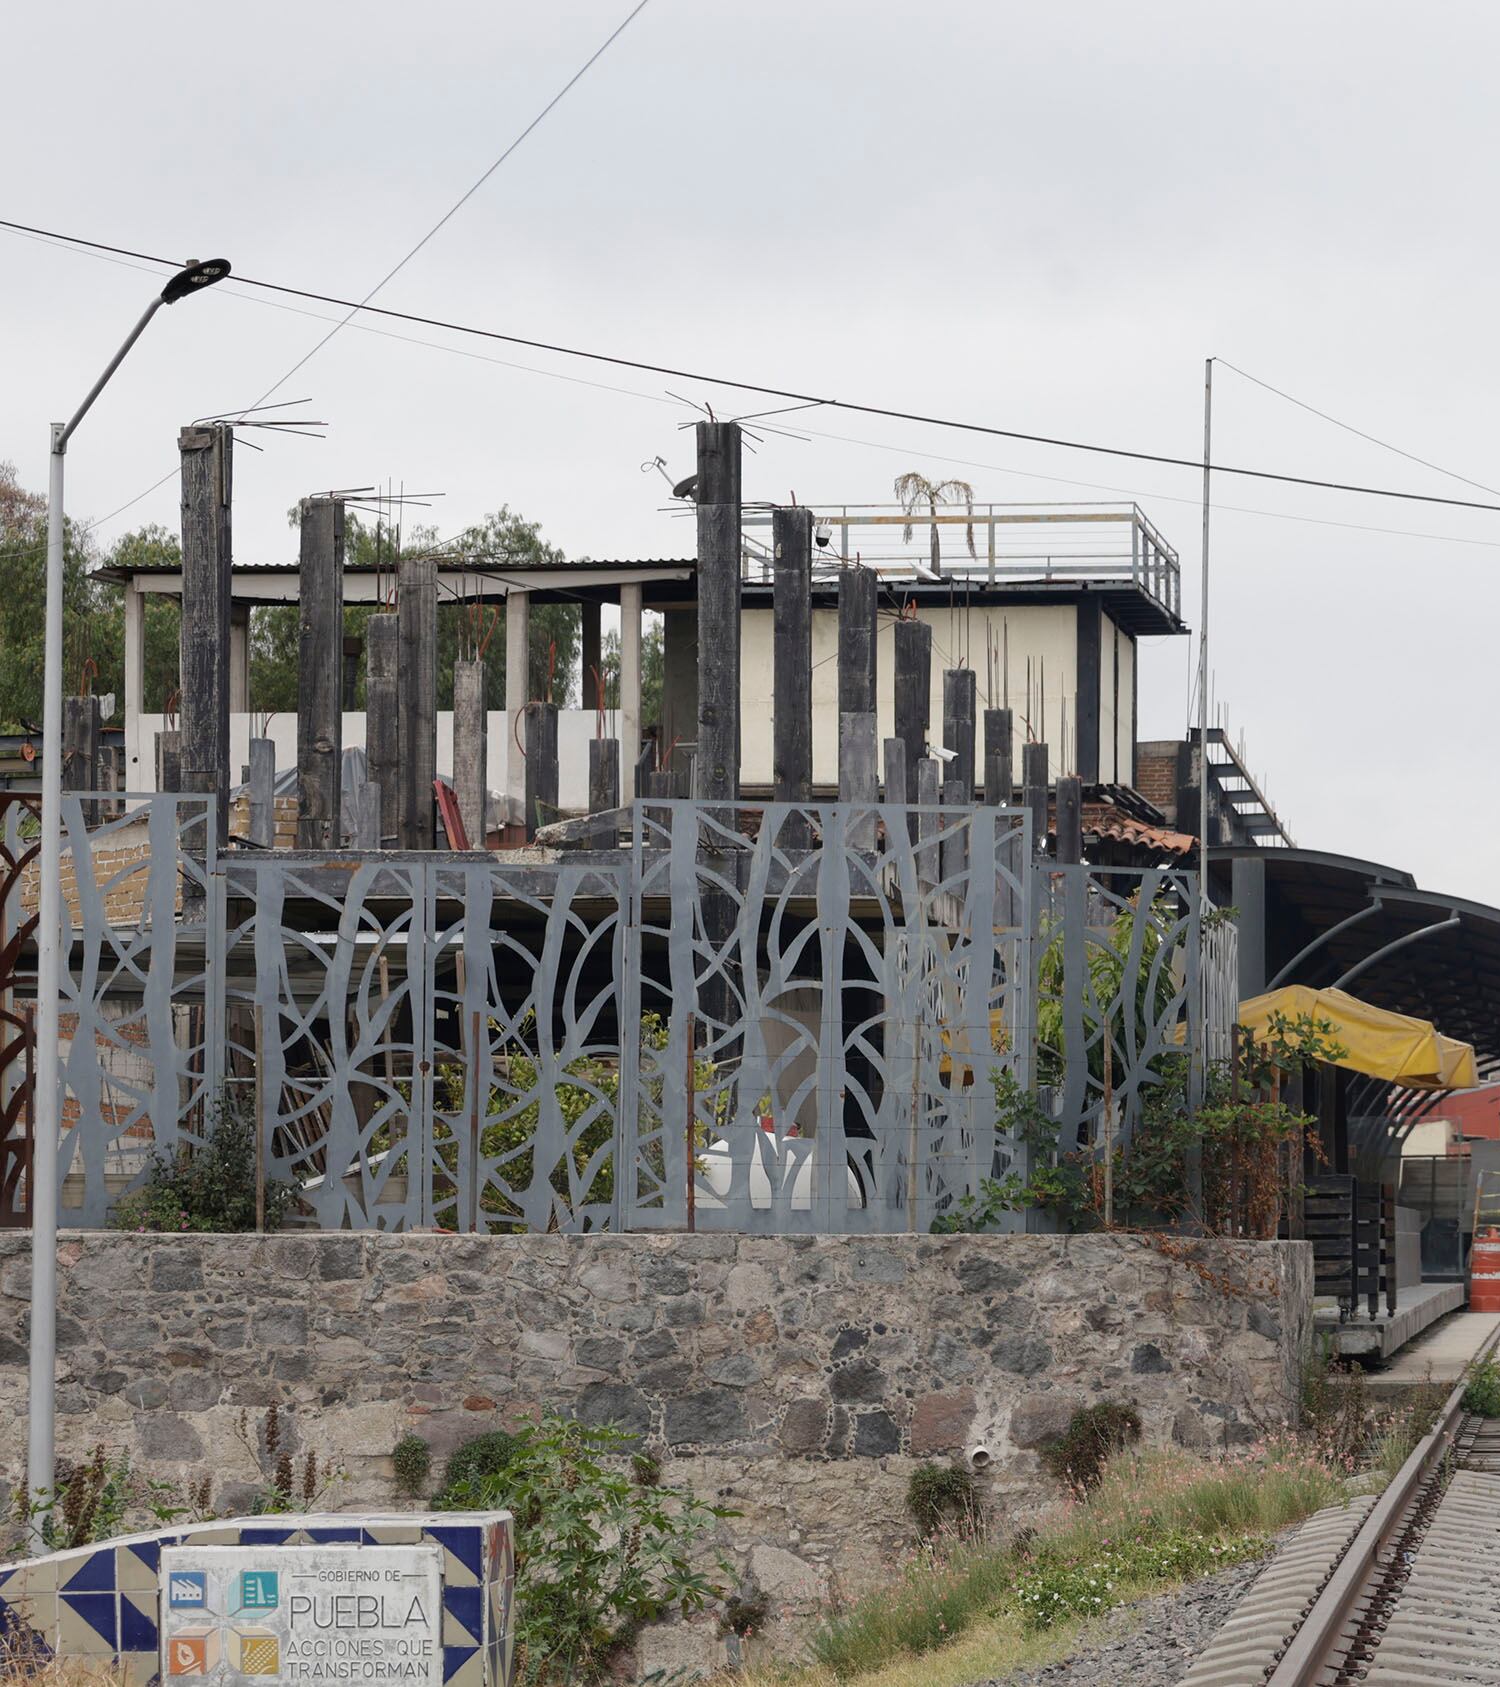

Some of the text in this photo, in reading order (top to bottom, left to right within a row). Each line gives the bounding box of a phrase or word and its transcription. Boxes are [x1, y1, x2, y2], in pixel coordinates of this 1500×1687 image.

[318, 1570, 401, 1582] GOBIERNO DE
[289, 1595, 430, 1629] PUEBLA
[286, 1639, 433, 1657] ACCIONES QUE
[287, 1661, 430, 1679] TRANSFORMAN
